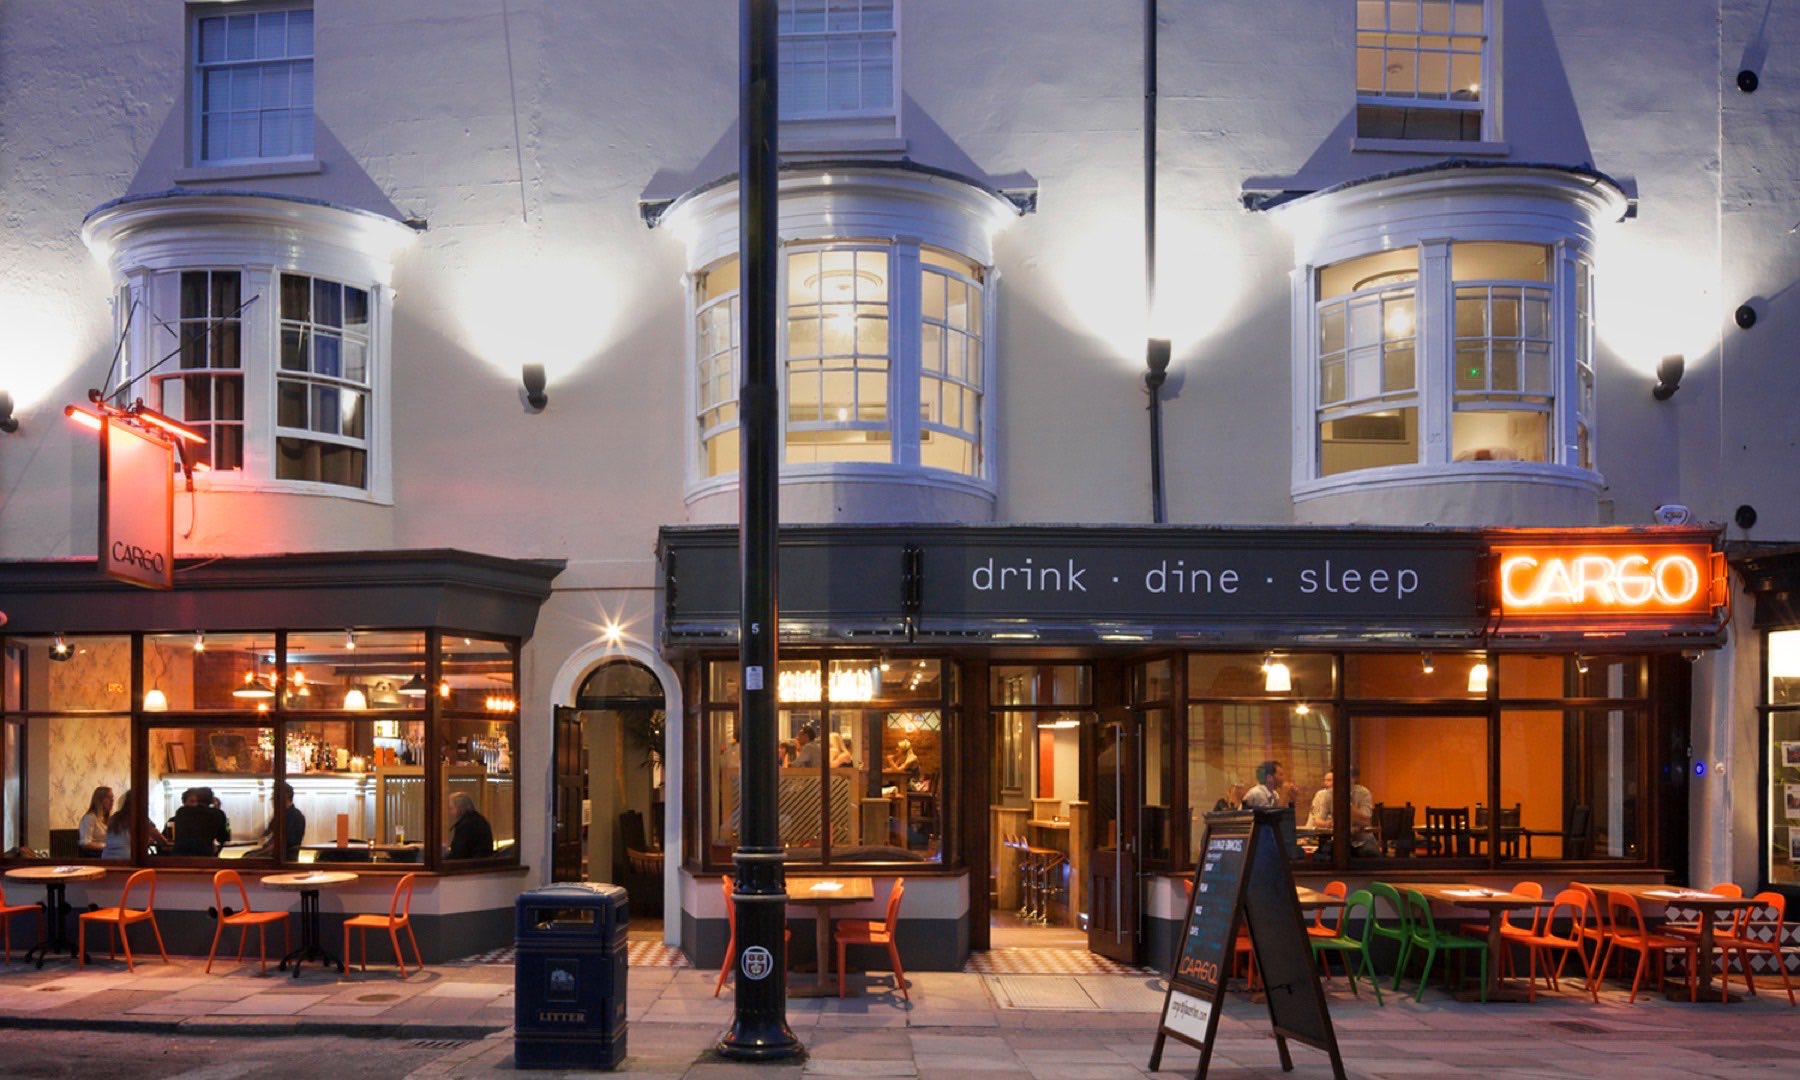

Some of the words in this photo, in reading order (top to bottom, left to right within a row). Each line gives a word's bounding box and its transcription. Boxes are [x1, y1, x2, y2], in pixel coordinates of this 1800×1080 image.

[112, 541, 164, 574] CARGO
[972, 558, 1087, 591] drink
[1145, 560, 1239, 593] dine
[1300, 560, 1418, 599] sleep
[1501, 555, 1699, 606] CARGO
[751, 623, 759, 634] 5
[539, 1012, 585, 1022] LITTER
